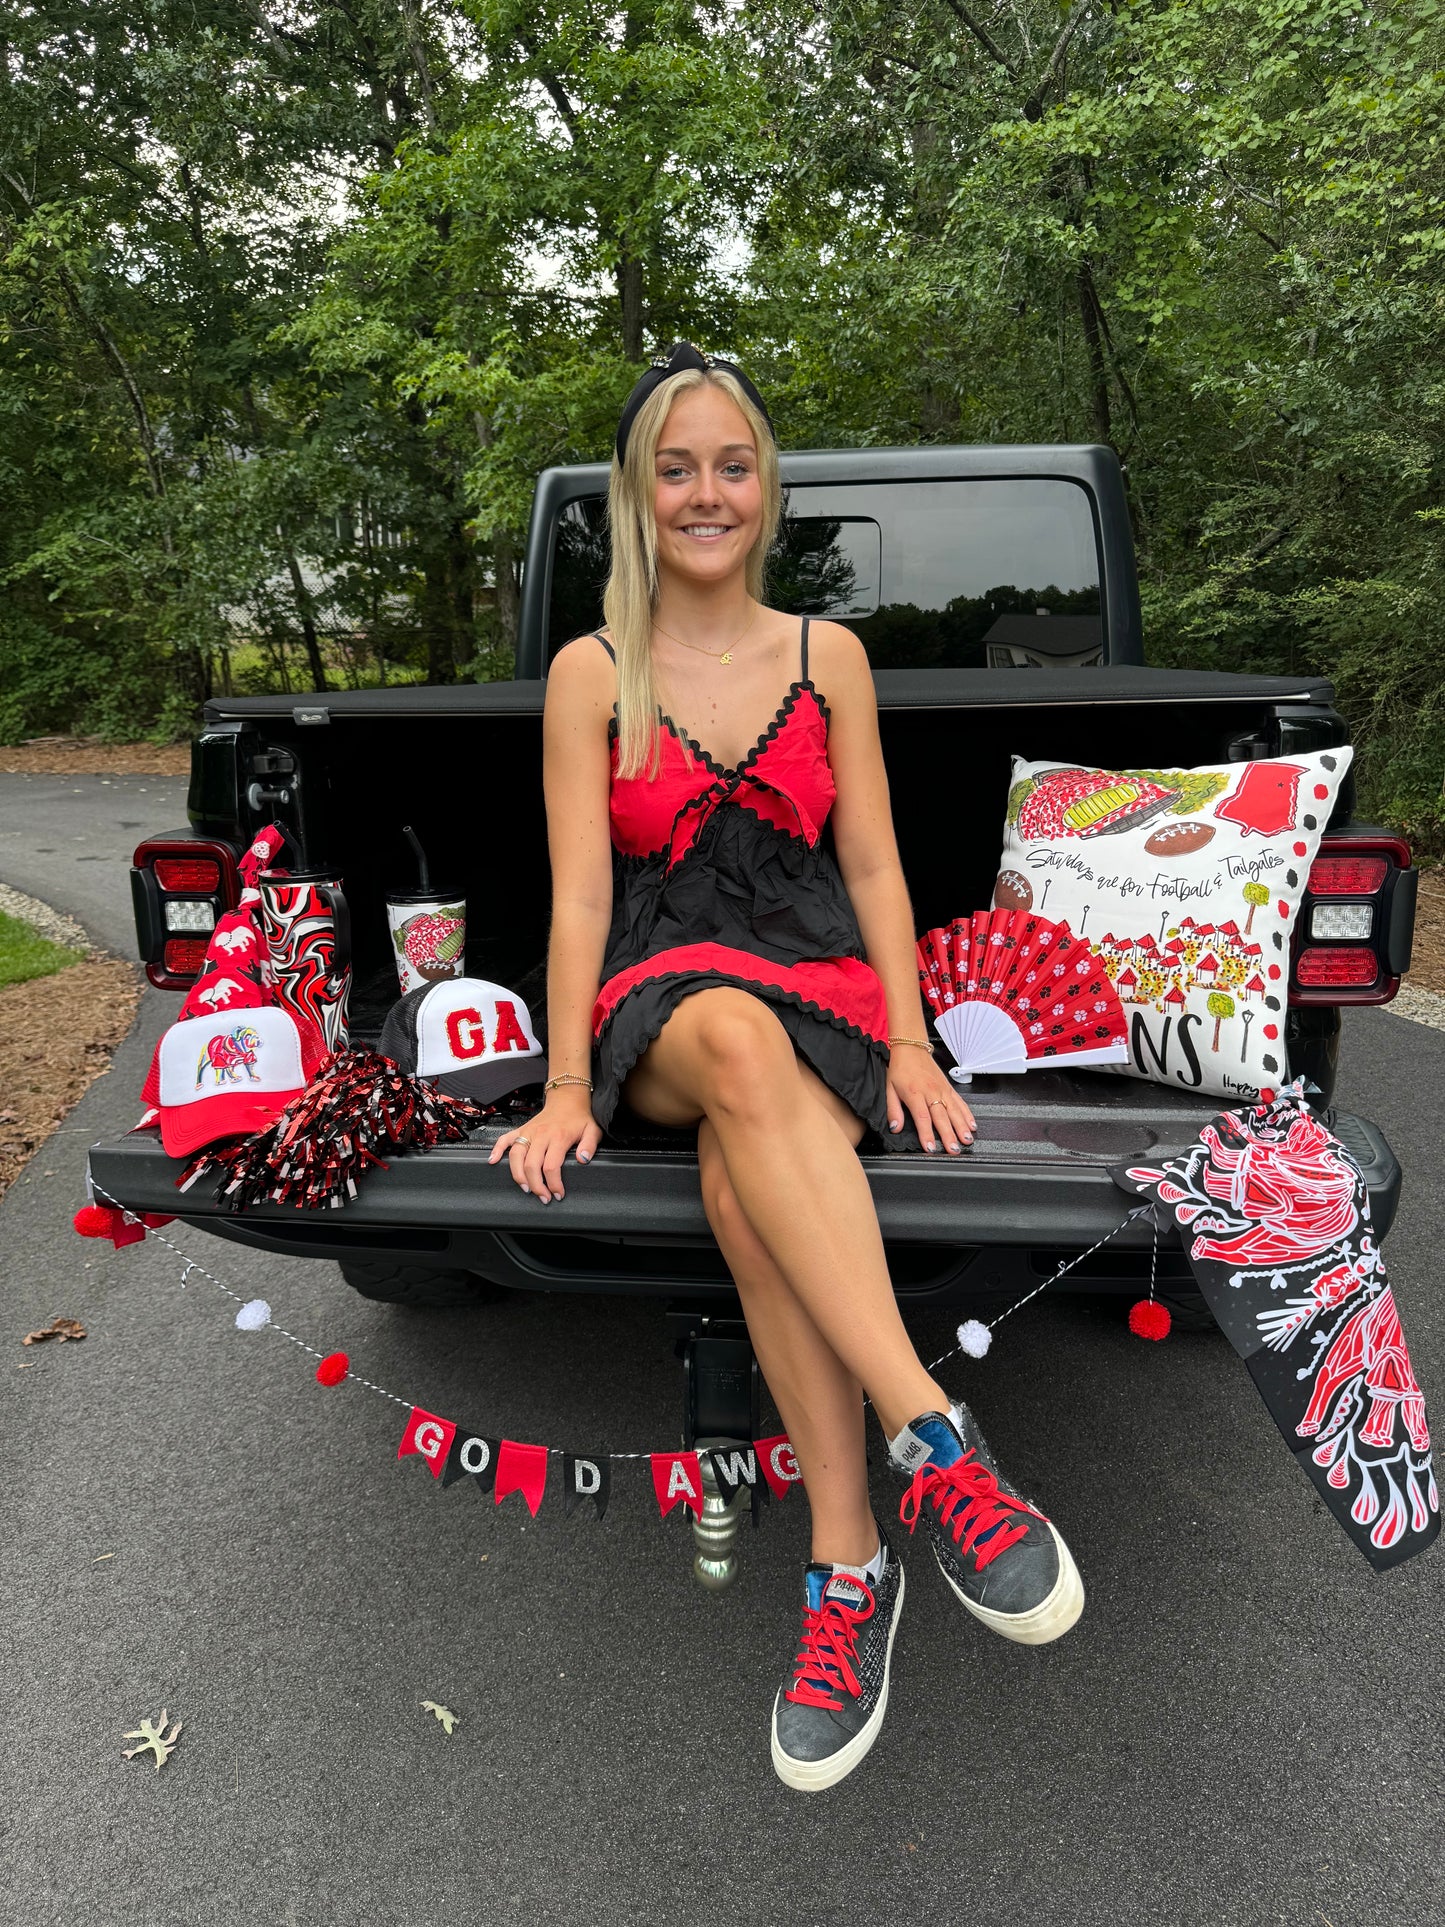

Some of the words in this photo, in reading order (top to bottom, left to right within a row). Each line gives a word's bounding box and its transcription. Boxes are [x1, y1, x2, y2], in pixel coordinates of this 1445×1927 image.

[1097, 876, 1119, 889] are
[1119, 877, 1144, 897] for
[1146, 873, 1212, 902] Football
[1217, 848, 1285, 882] Tailgates
[444, 1001, 530, 1062] GA
[1131, 1011, 1203, 1087] NS
[1222, 1073, 1260, 1099] Happy
[414, 1421, 490, 1473] GO
